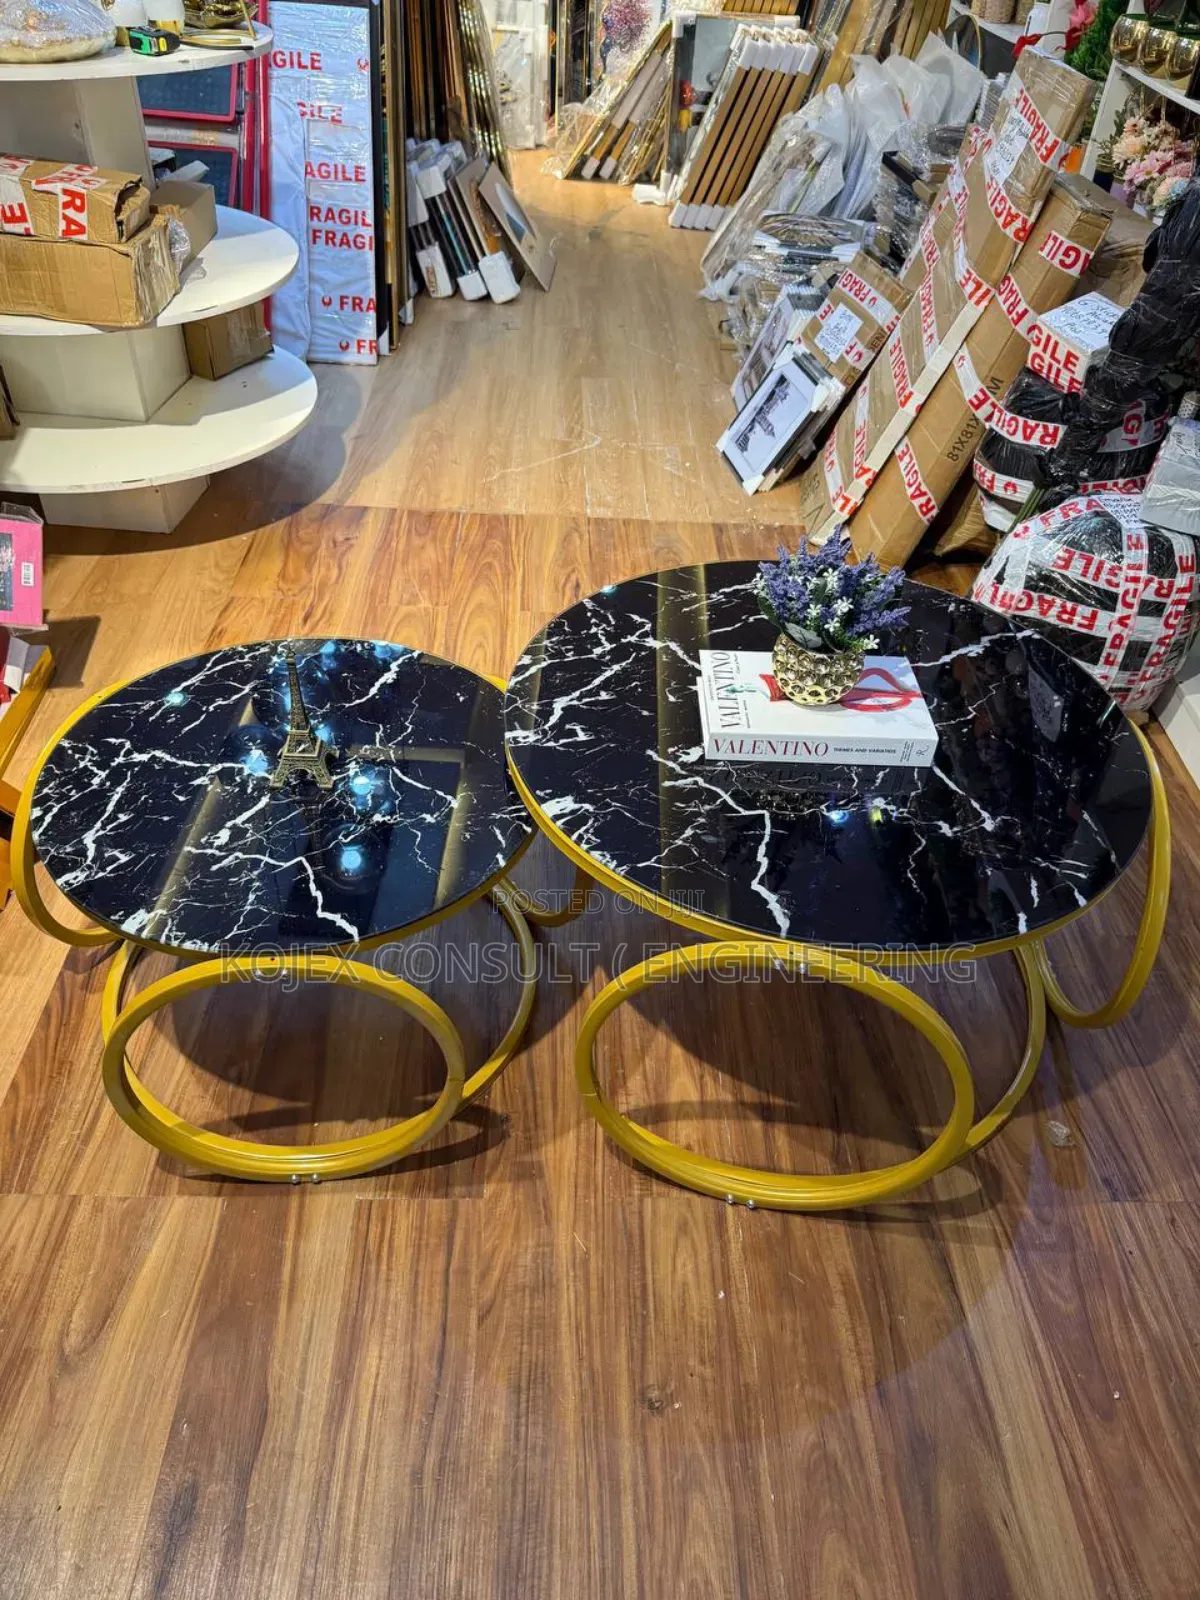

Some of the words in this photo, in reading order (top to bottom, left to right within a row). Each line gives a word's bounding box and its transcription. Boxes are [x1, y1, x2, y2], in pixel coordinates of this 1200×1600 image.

[269, 50, 322, 71] GILE
[304, 160, 366, 182] AGILE
[311, 229, 374, 251] FRAGI
[711, 652, 741, 729] VALENTINO
[714, 738, 829, 756] VALENTINO
